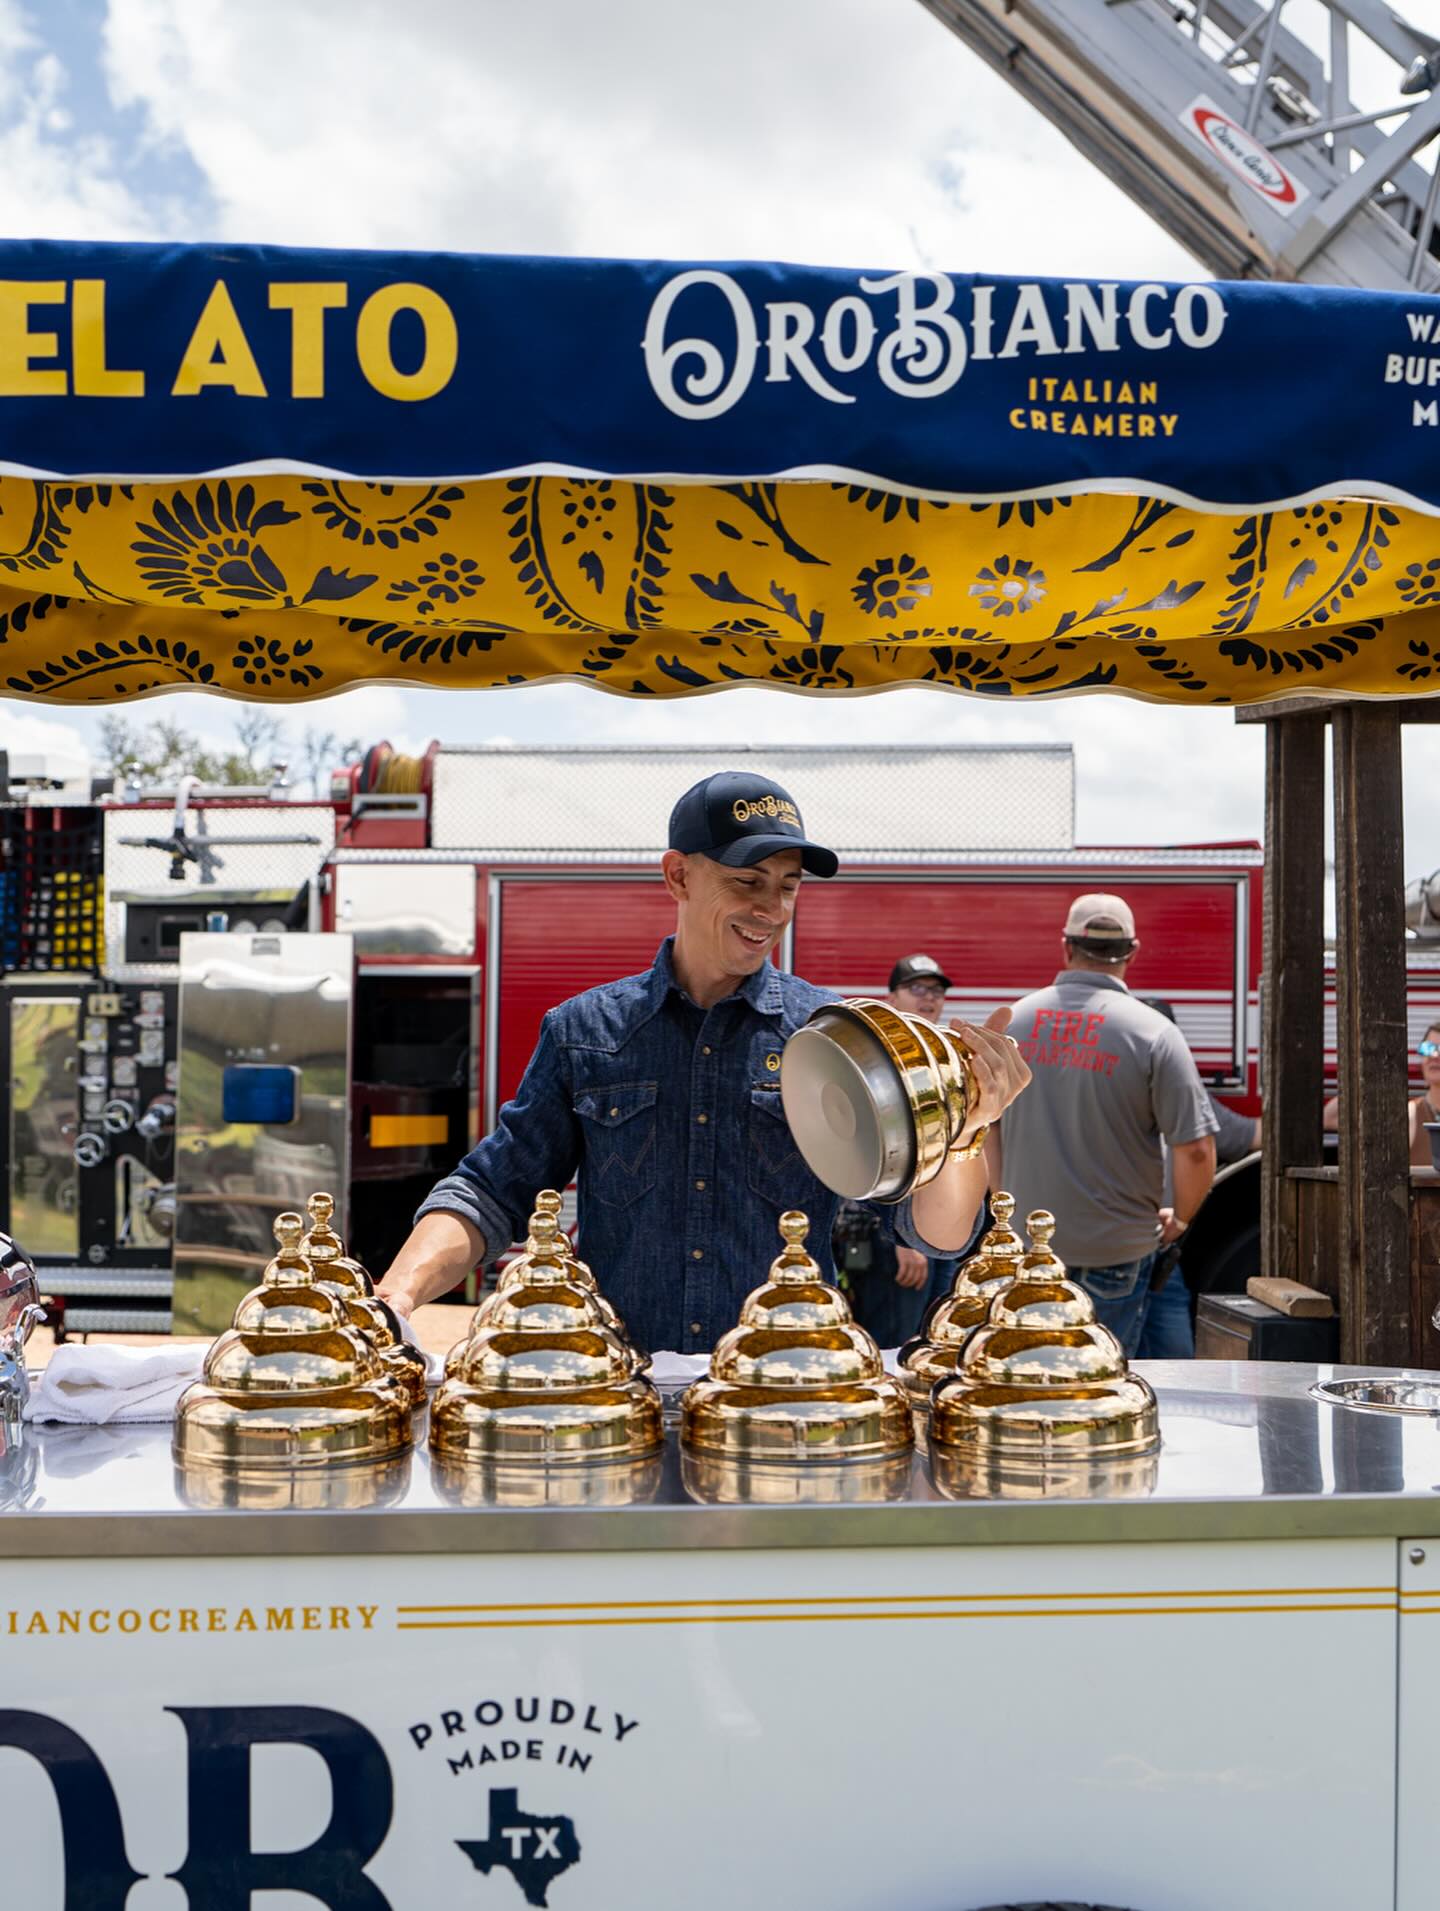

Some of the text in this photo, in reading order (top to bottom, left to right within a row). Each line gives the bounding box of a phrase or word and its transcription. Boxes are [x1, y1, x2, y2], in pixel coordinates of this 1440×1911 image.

[1028, 377, 1158, 404] ITALIAN
[1009, 408, 1179, 437] CREAMERY
[1030, 1007, 1105, 1047] FIRE
[0, 1606, 379, 1634] IANCOCREAMERY
[409, 1697, 639, 1750] PROUDLY
[447, 1740, 593, 1776] MADE IN
[501, 1827, 562, 1859] TX
